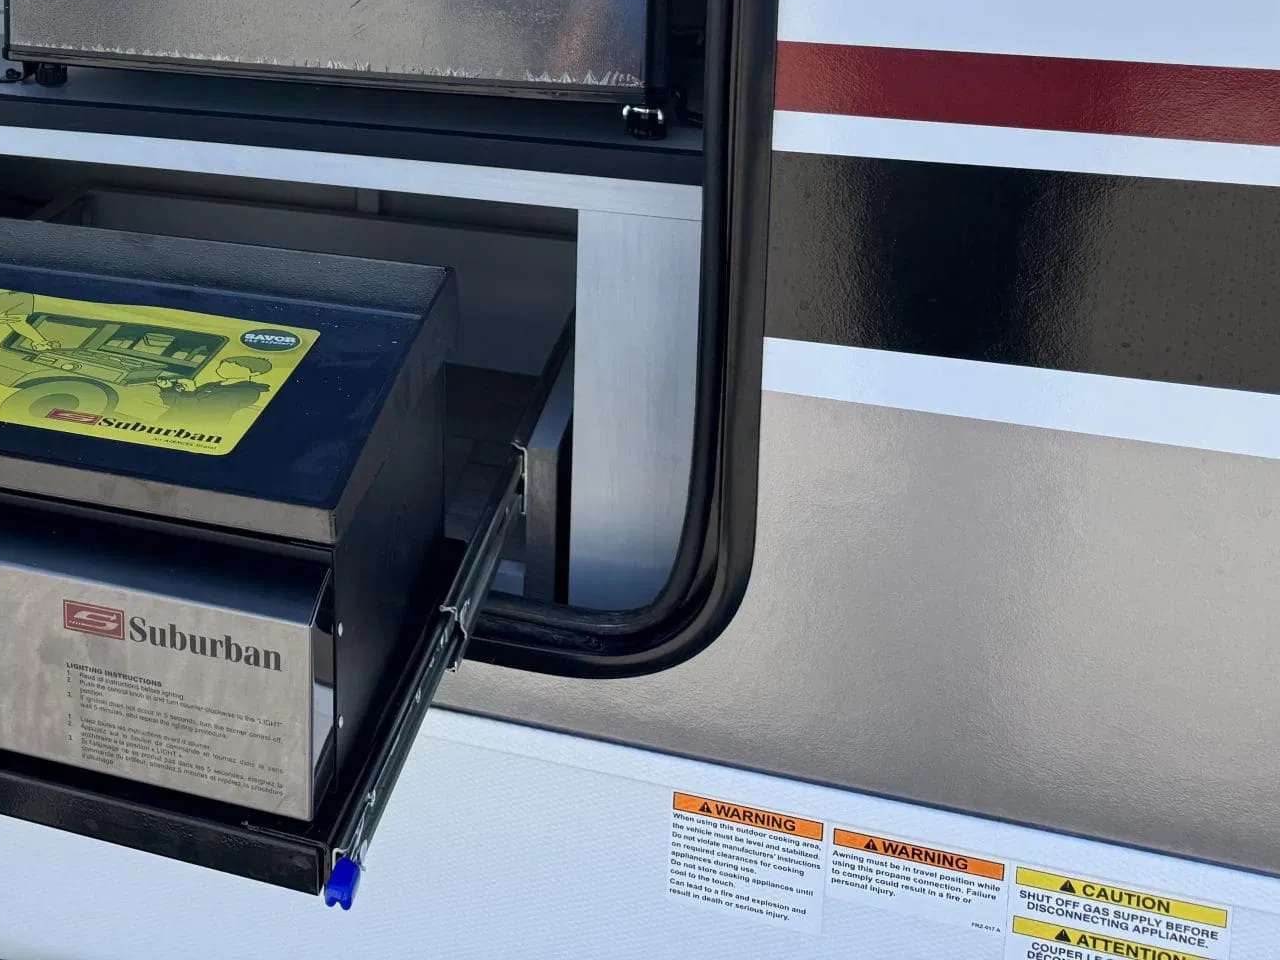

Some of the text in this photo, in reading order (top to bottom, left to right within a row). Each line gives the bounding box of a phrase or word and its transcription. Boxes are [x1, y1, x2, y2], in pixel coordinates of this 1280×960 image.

[98, 417, 222, 443] Suburban
[129, 616, 282, 672] Suburban
[673, 812, 822, 852] When using this outdoor cooking area,
[714, 804, 796, 832] WARNING
[672, 831, 682, 839] Do
[683, 835, 696, 843] not
[697, 837, 720, 848] violate
[672, 822, 820, 861] the vehicle must be level and stabilized.
[882, 841, 968, 870] WARNING
[670, 851, 757, 874] appliances during use.
[670, 858, 814, 896] Do not store cooking appliances until
[683, 844, 714, 856] required
[716, 850, 758, 865] clearances
[760, 860, 771, 868] for
[772, 864, 804, 877] cooking
[832, 850, 1001, 892] Awning must be in travel position while
[670, 869, 686, 877] cool
[698, 874, 710, 882] the
[711, 877, 736, 888] touch.
[830, 878, 896, 898] personal injury.
[832, 860, 996, 900] using this propane connection. Failure
[842, 871, 872, 884] comply
[875, 878, 899, 888] could
[901, 884, 926, 894] result
[946, 893, 960, 901] fire
[669, 888, 690, 897] result
[701, 894, 722, 905] death
[735, 903, 764, 914] serious
[765, 909, 790, 921] injury.
[670, 878, 684, 887] Can
[686, 881, 702, 891] lead
[704, 885, 712, 893] to
[720, 889, 733, 898] fire
[751, 897, 790, 911] explosion
[791, 906, 806, 914] and
[1082, 884, 1170, 914] CAUTION
[1019, 890, 1219, 940] SHUT OFF GAS SUPPLY BEFORE
[1027, 902, 1209, 948] DISCONNECTING APPLIANCE.
[1031, 941, 1082, 960] COUPER
